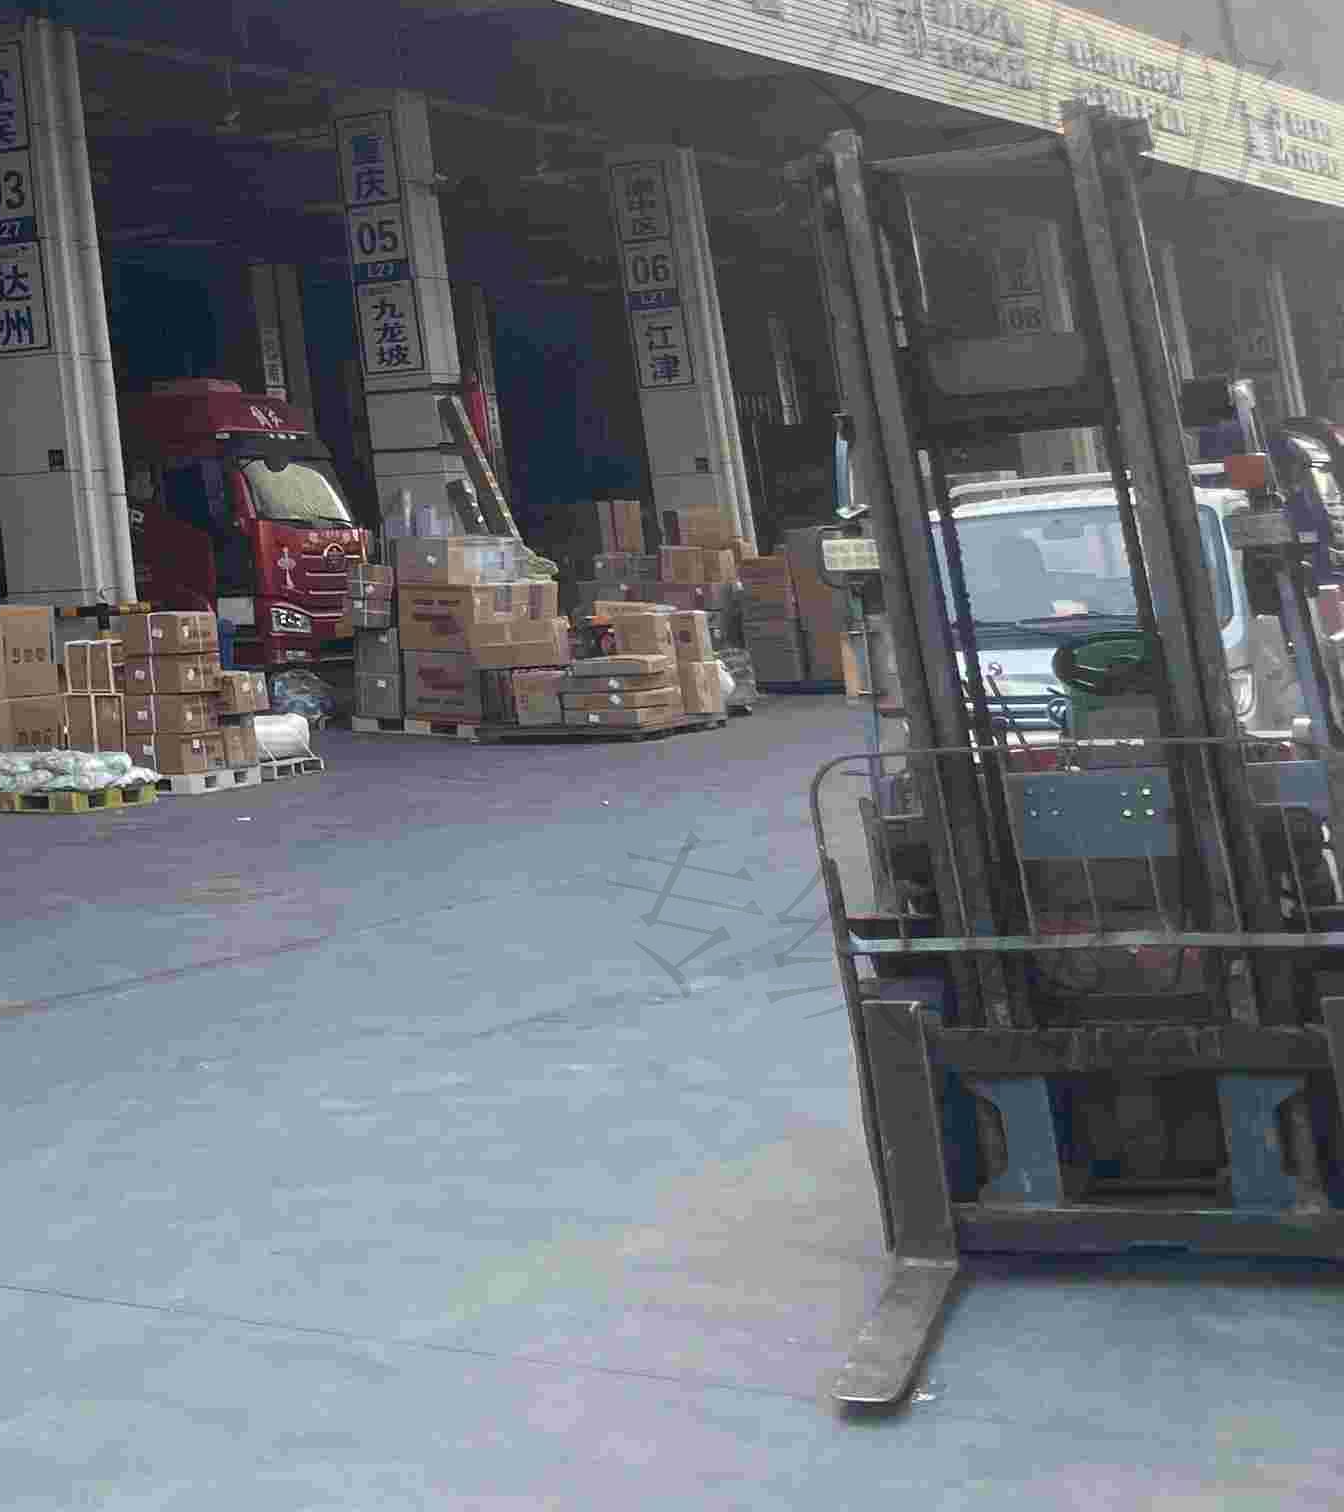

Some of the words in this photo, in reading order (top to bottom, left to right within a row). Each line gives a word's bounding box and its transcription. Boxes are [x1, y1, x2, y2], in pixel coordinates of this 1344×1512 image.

[357, 219, 399, 255] 05
[632, 254, 670, 285] 06
[373, 299, 412, 367] 九龙坡
[643, 325, 680, 384] 江津
